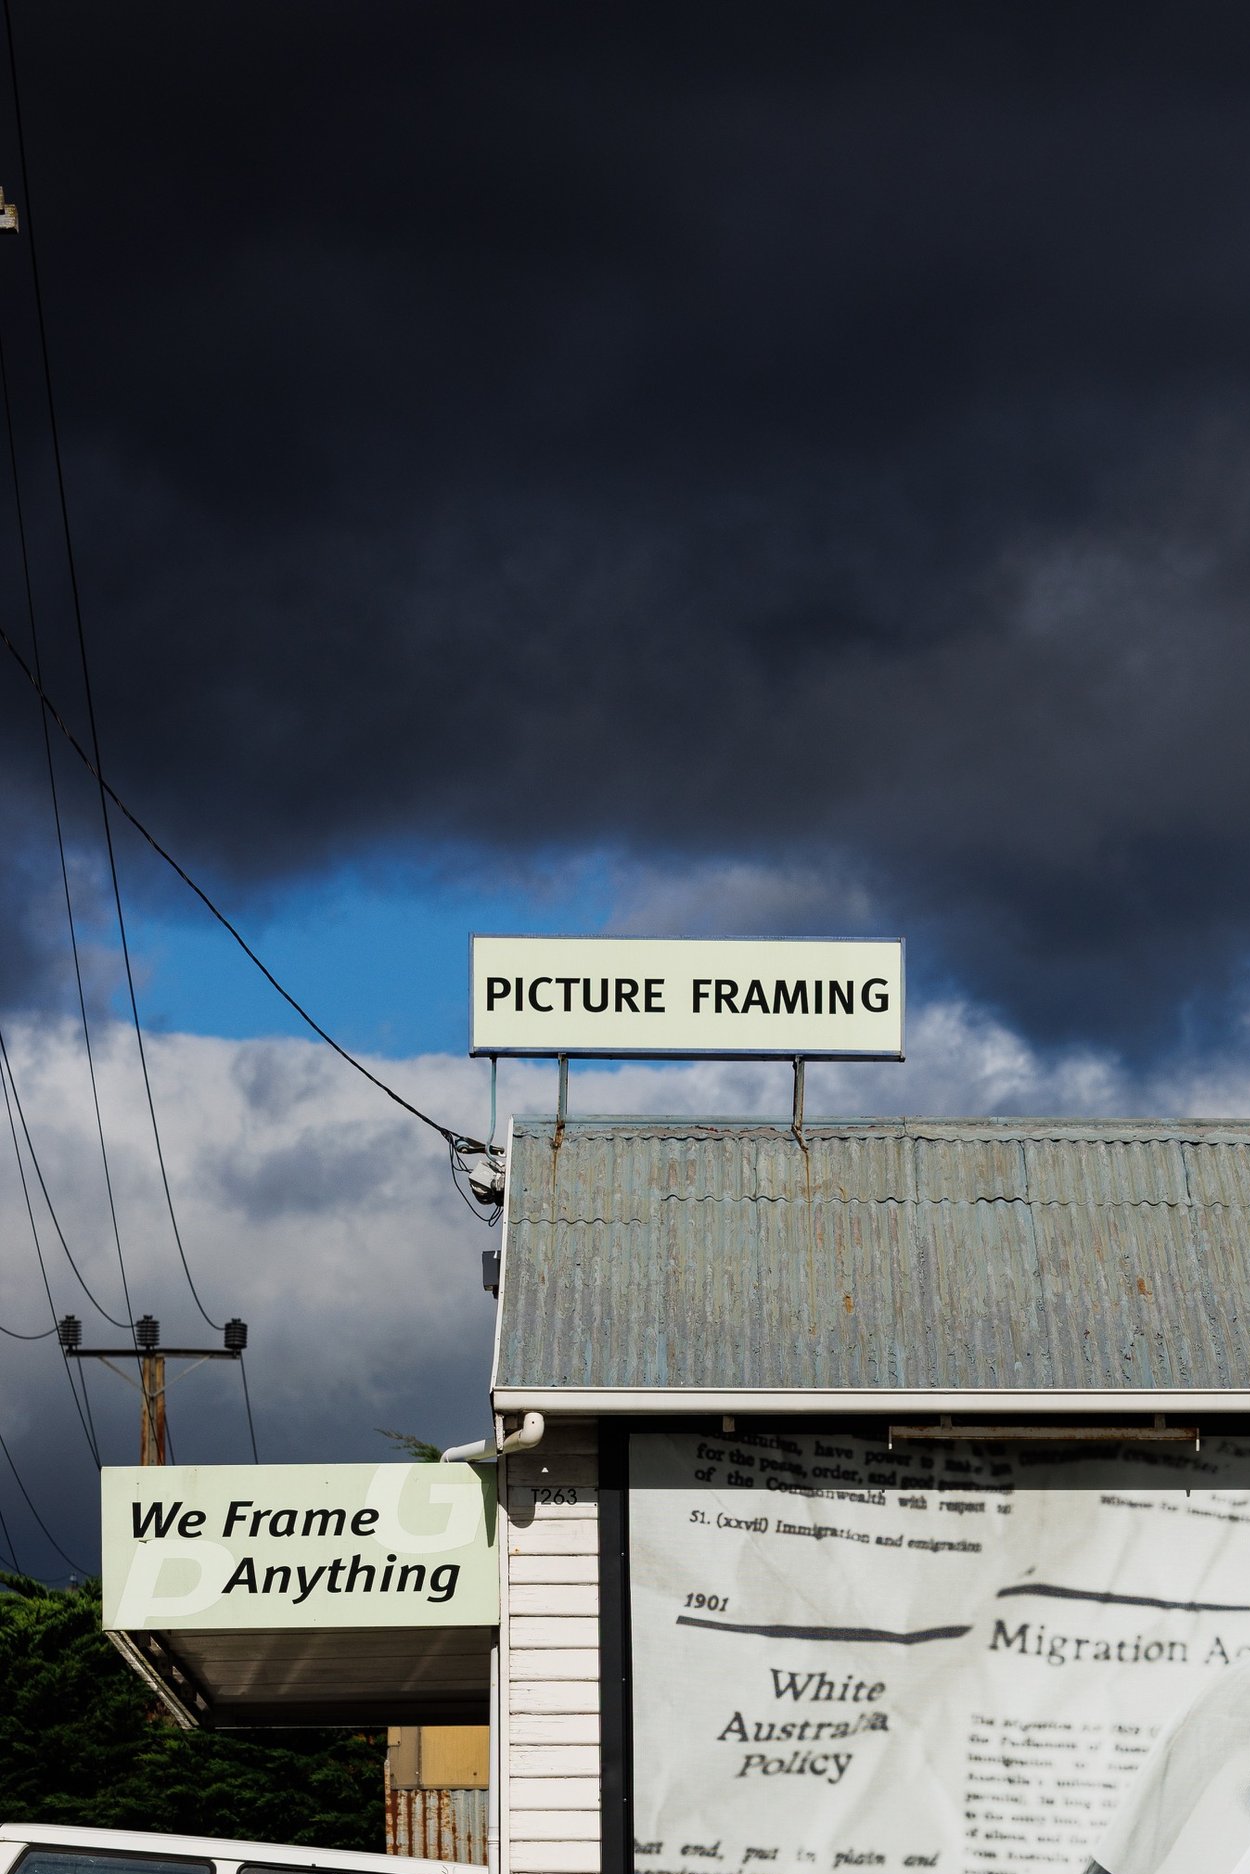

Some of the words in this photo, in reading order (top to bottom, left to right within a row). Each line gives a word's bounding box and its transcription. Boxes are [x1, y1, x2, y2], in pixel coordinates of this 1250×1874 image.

[485, 976, 666, 1014] PICTURE
[692, 977, 890, 1015] FRAMING
[696, 1443, 725, 1461] for
[729, 1449, 755, 1467] the
[812, 1464, 863, 1484] order,
[868, 1471, 897, 1486] and
[815, 1440, 853, 1459] have
[694, 1467, 716, 1482] of
[728, 1470, 754, 1488] the
[765, 1477, 886, 1505] Commonwealth
[131, 1500, 207, 1539] We
[221, 1500, 380, 1538] Frame
[689, 1510, 711, 1525] 51.
[775, 1520, 870, 1544] Immigration
[874, 1534, 903, 1548] and
[220, 1553, 461, 1605] Anything
[683, 1592, 729, 1613] 1901
[988, 1618, 1188, 1666] Migration
[769, 1667, 886, 1703] White
[716, 1710, 890, 1743] Australia
[734, 1749, 853, 1785] Policy
[904, 1849, 941, 1868] and
